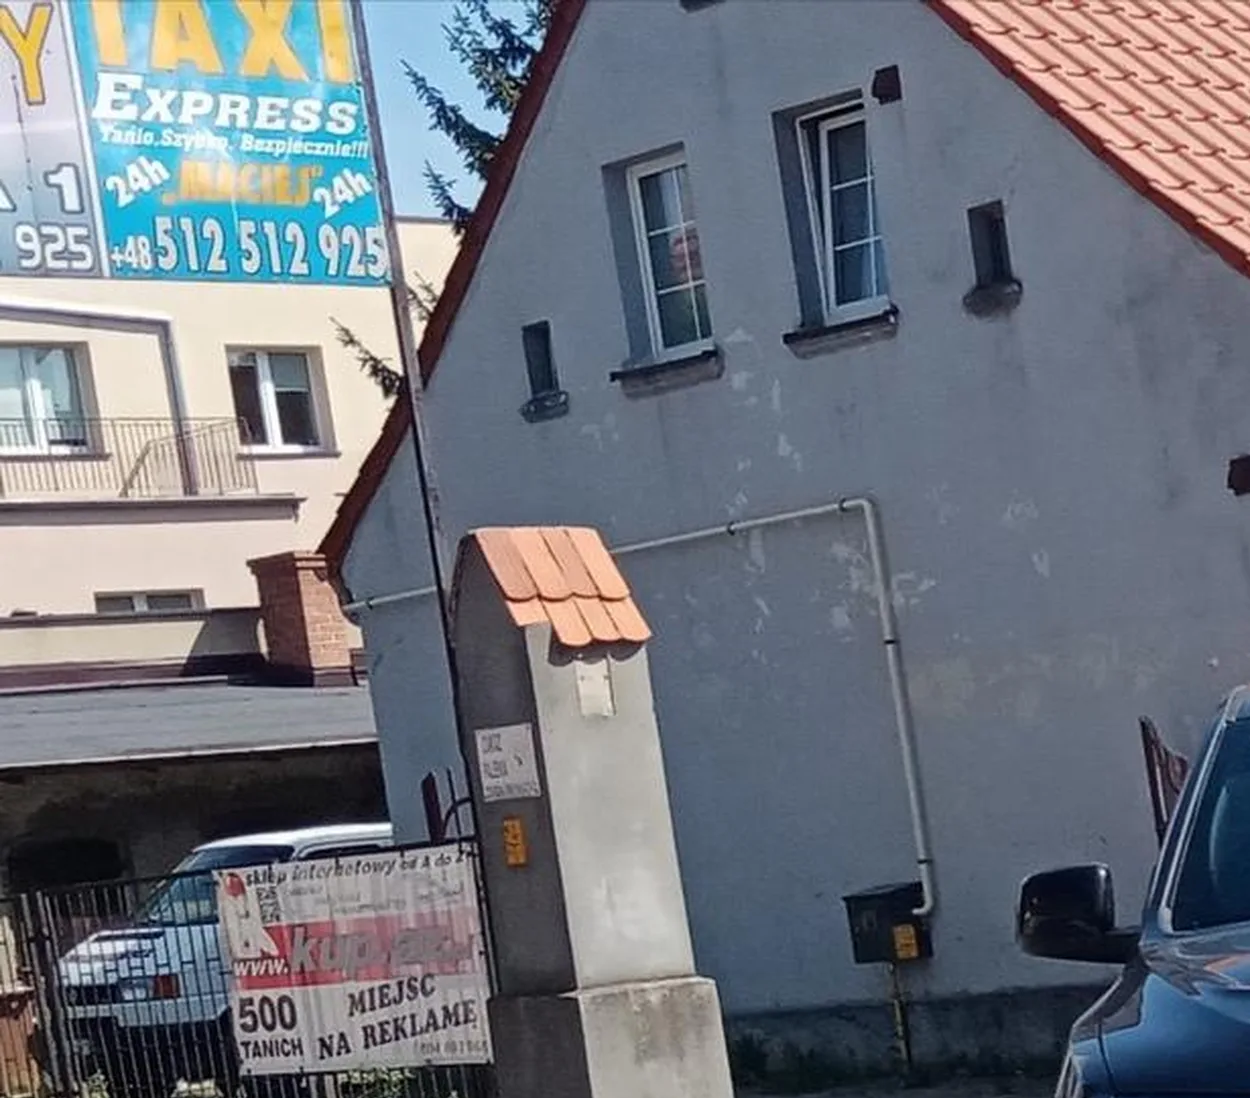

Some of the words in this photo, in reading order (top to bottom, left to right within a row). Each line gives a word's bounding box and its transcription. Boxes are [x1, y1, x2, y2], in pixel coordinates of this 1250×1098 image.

[90, 0, 357, 84] TAXI
[44, 163, 84, 213] 1
[104, 157, 170, 208] 24h
[313, 168, 374, 219] 24h
[14, 221, 94, 271] 925
[153, 215, 229, 272] 512
[237, 219, 310, 275] 512
[317, 223, 389, 279] 925
[238, 994, 298, 1034] 500
[347, 973, 436, 1018] MIEJSC
[240, 1037, 304, 1060] TANICH
[317, 1031, 352, 1060] NA
